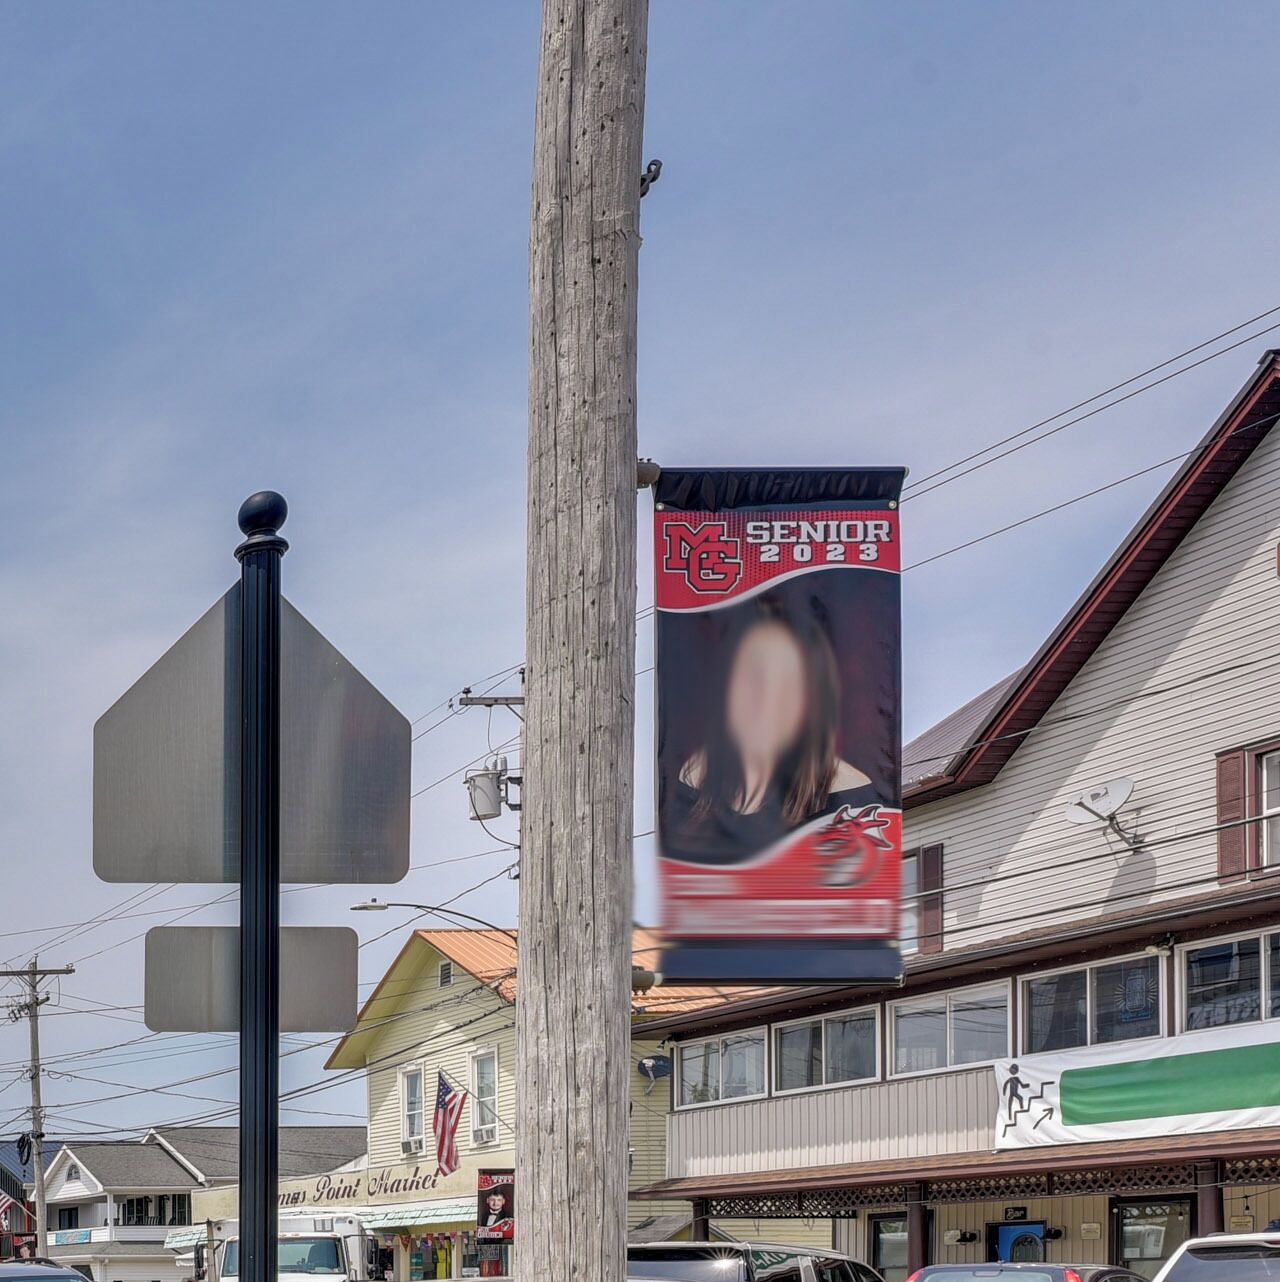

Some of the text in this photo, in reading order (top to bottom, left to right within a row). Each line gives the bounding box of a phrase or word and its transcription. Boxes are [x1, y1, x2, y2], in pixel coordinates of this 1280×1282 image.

[746, 520, 890, 543] SENIOR
[760, 544, 879, 562] 2023
[313, 1175, 361, 1202] Point
[368, 1167, 440, 1197] Market
[1006, 1208, 1025, 1220] Bar
